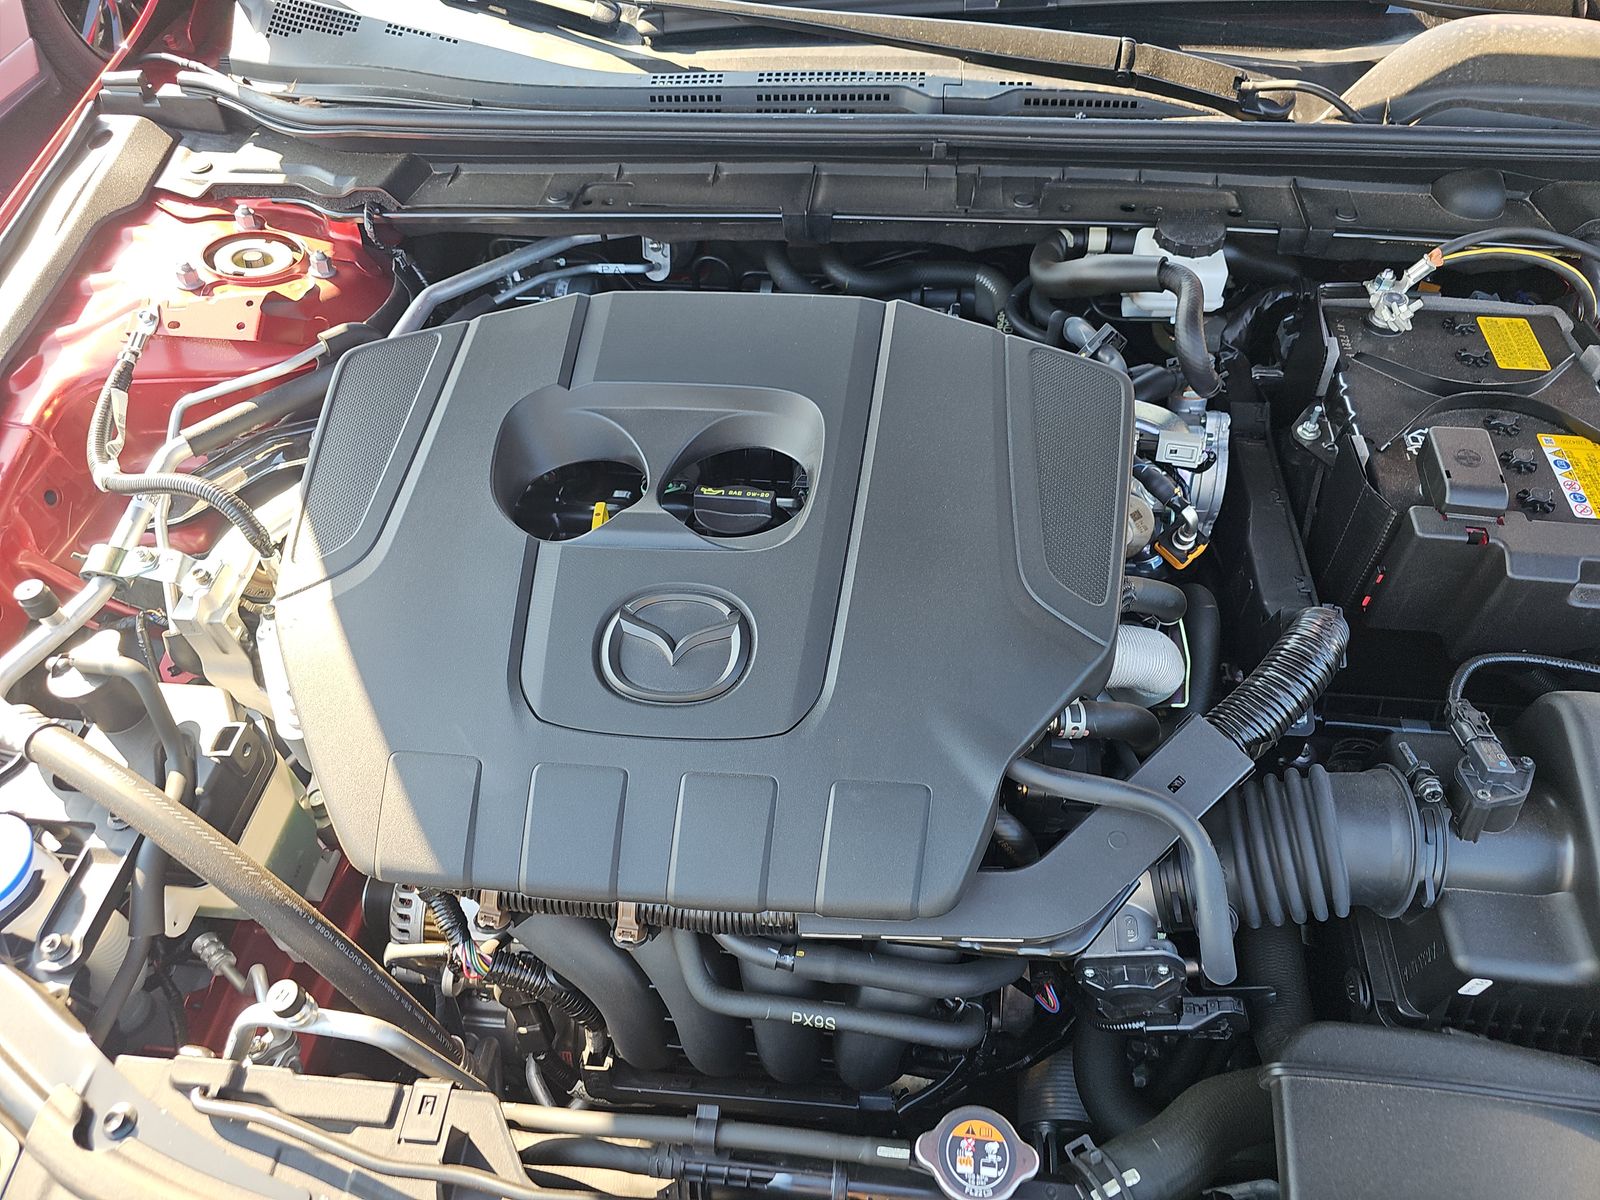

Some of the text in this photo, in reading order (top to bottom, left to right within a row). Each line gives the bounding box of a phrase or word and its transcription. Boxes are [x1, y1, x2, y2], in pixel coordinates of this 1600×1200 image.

[315, 923, 336, 942] HOSE
[335, 939, 363, 966] SUCTION
[791, 1011, 836, 1031] PX9S
